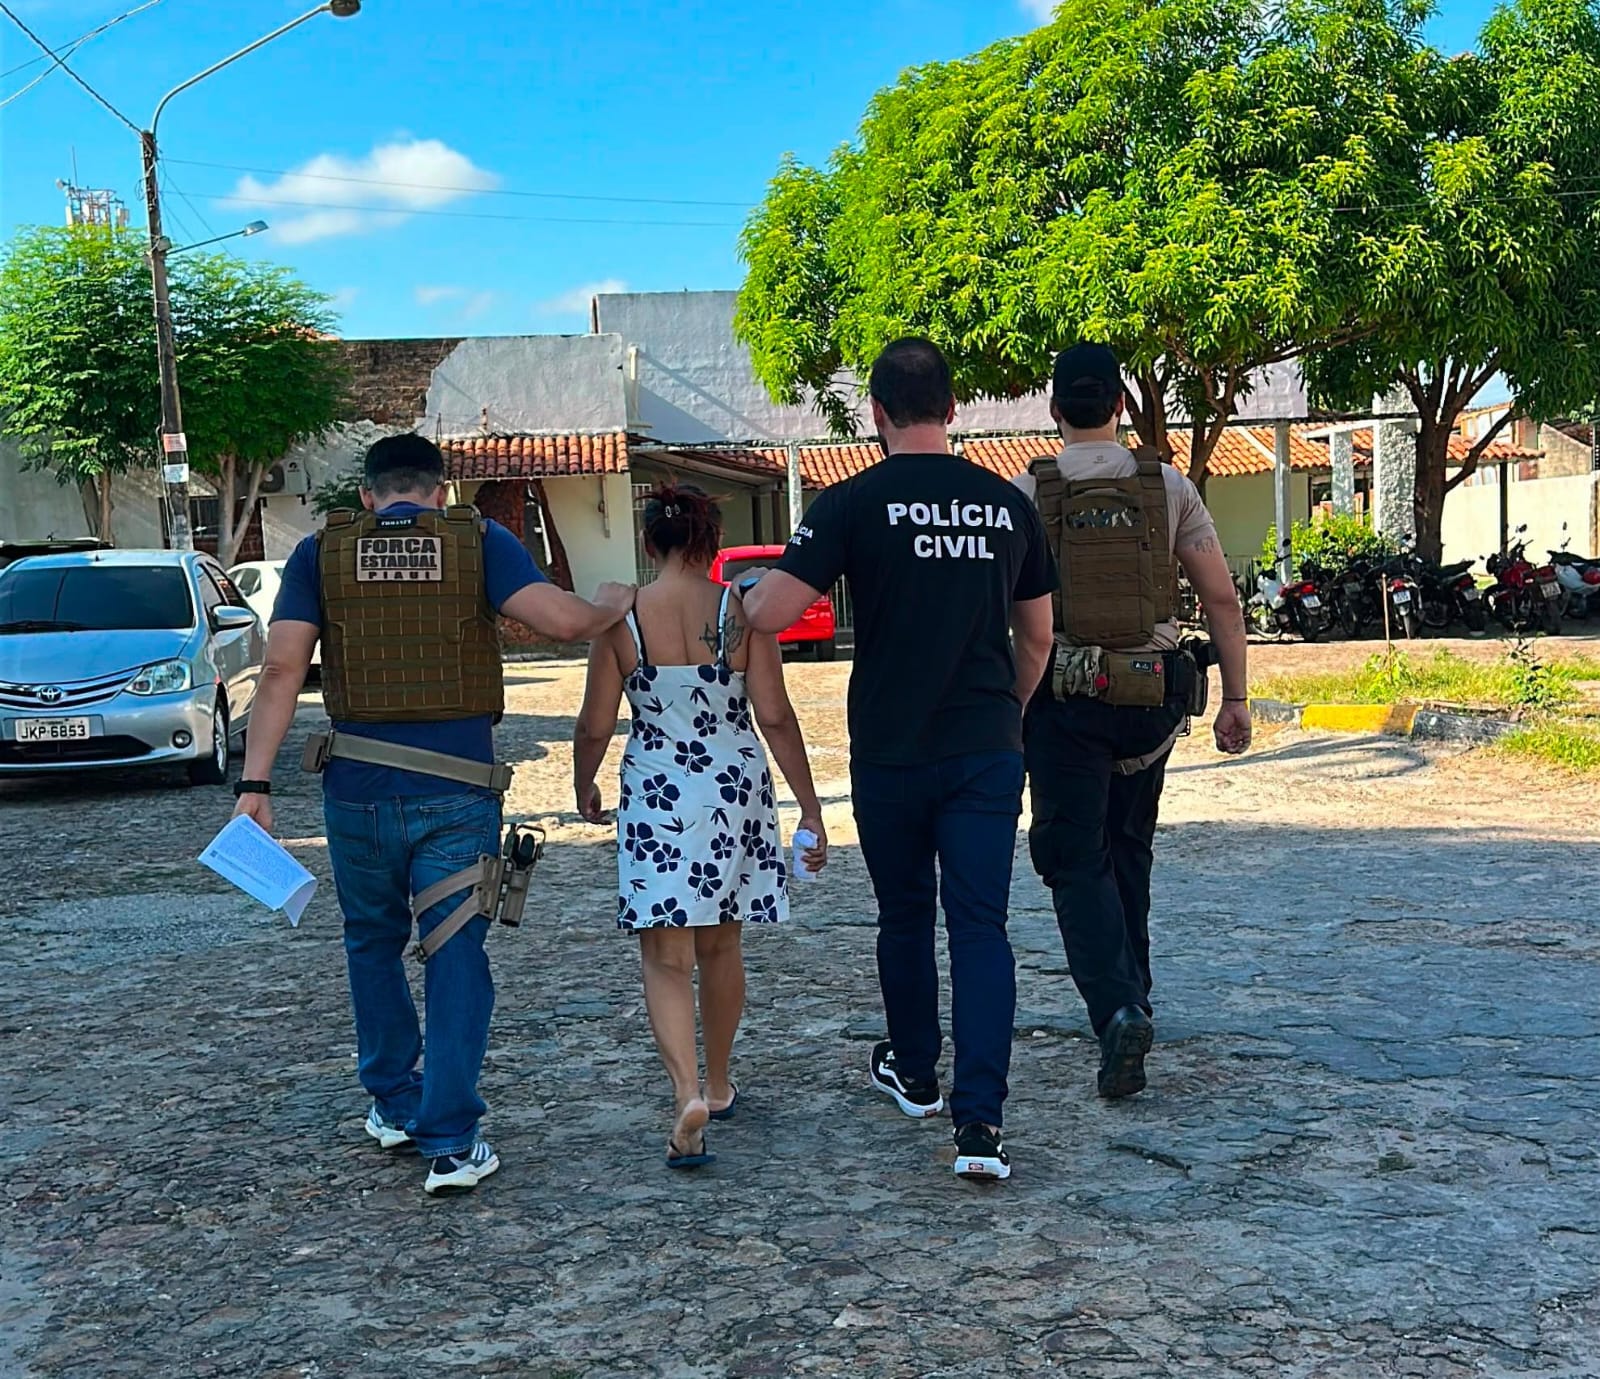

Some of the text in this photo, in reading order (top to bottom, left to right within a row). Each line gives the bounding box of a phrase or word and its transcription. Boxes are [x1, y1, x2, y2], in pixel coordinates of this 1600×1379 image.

[887, 500, 1014, 531] POLÍCIA
[913, 534, 994, 560] CIVIL
[361, 556, 437, 567] ESTADUAL
